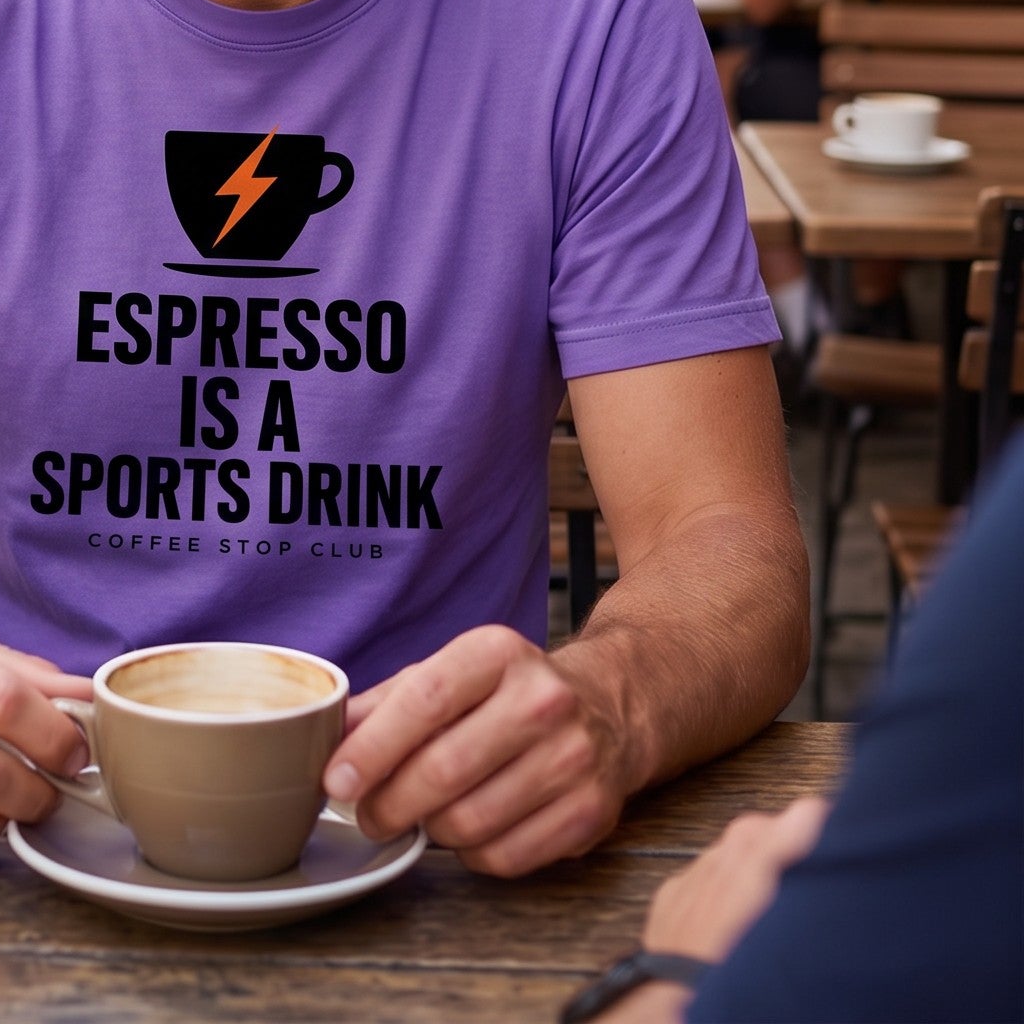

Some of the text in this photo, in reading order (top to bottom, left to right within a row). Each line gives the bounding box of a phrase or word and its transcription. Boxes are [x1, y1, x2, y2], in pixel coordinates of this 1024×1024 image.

[76, 290, 407, 374] ESPRESSO
[179, 375, 301, 453] IS A
[29, 450, 444, 531] SPORTS DRINK
[87, 532, 384, 560] COFFEE STOP CLUB
